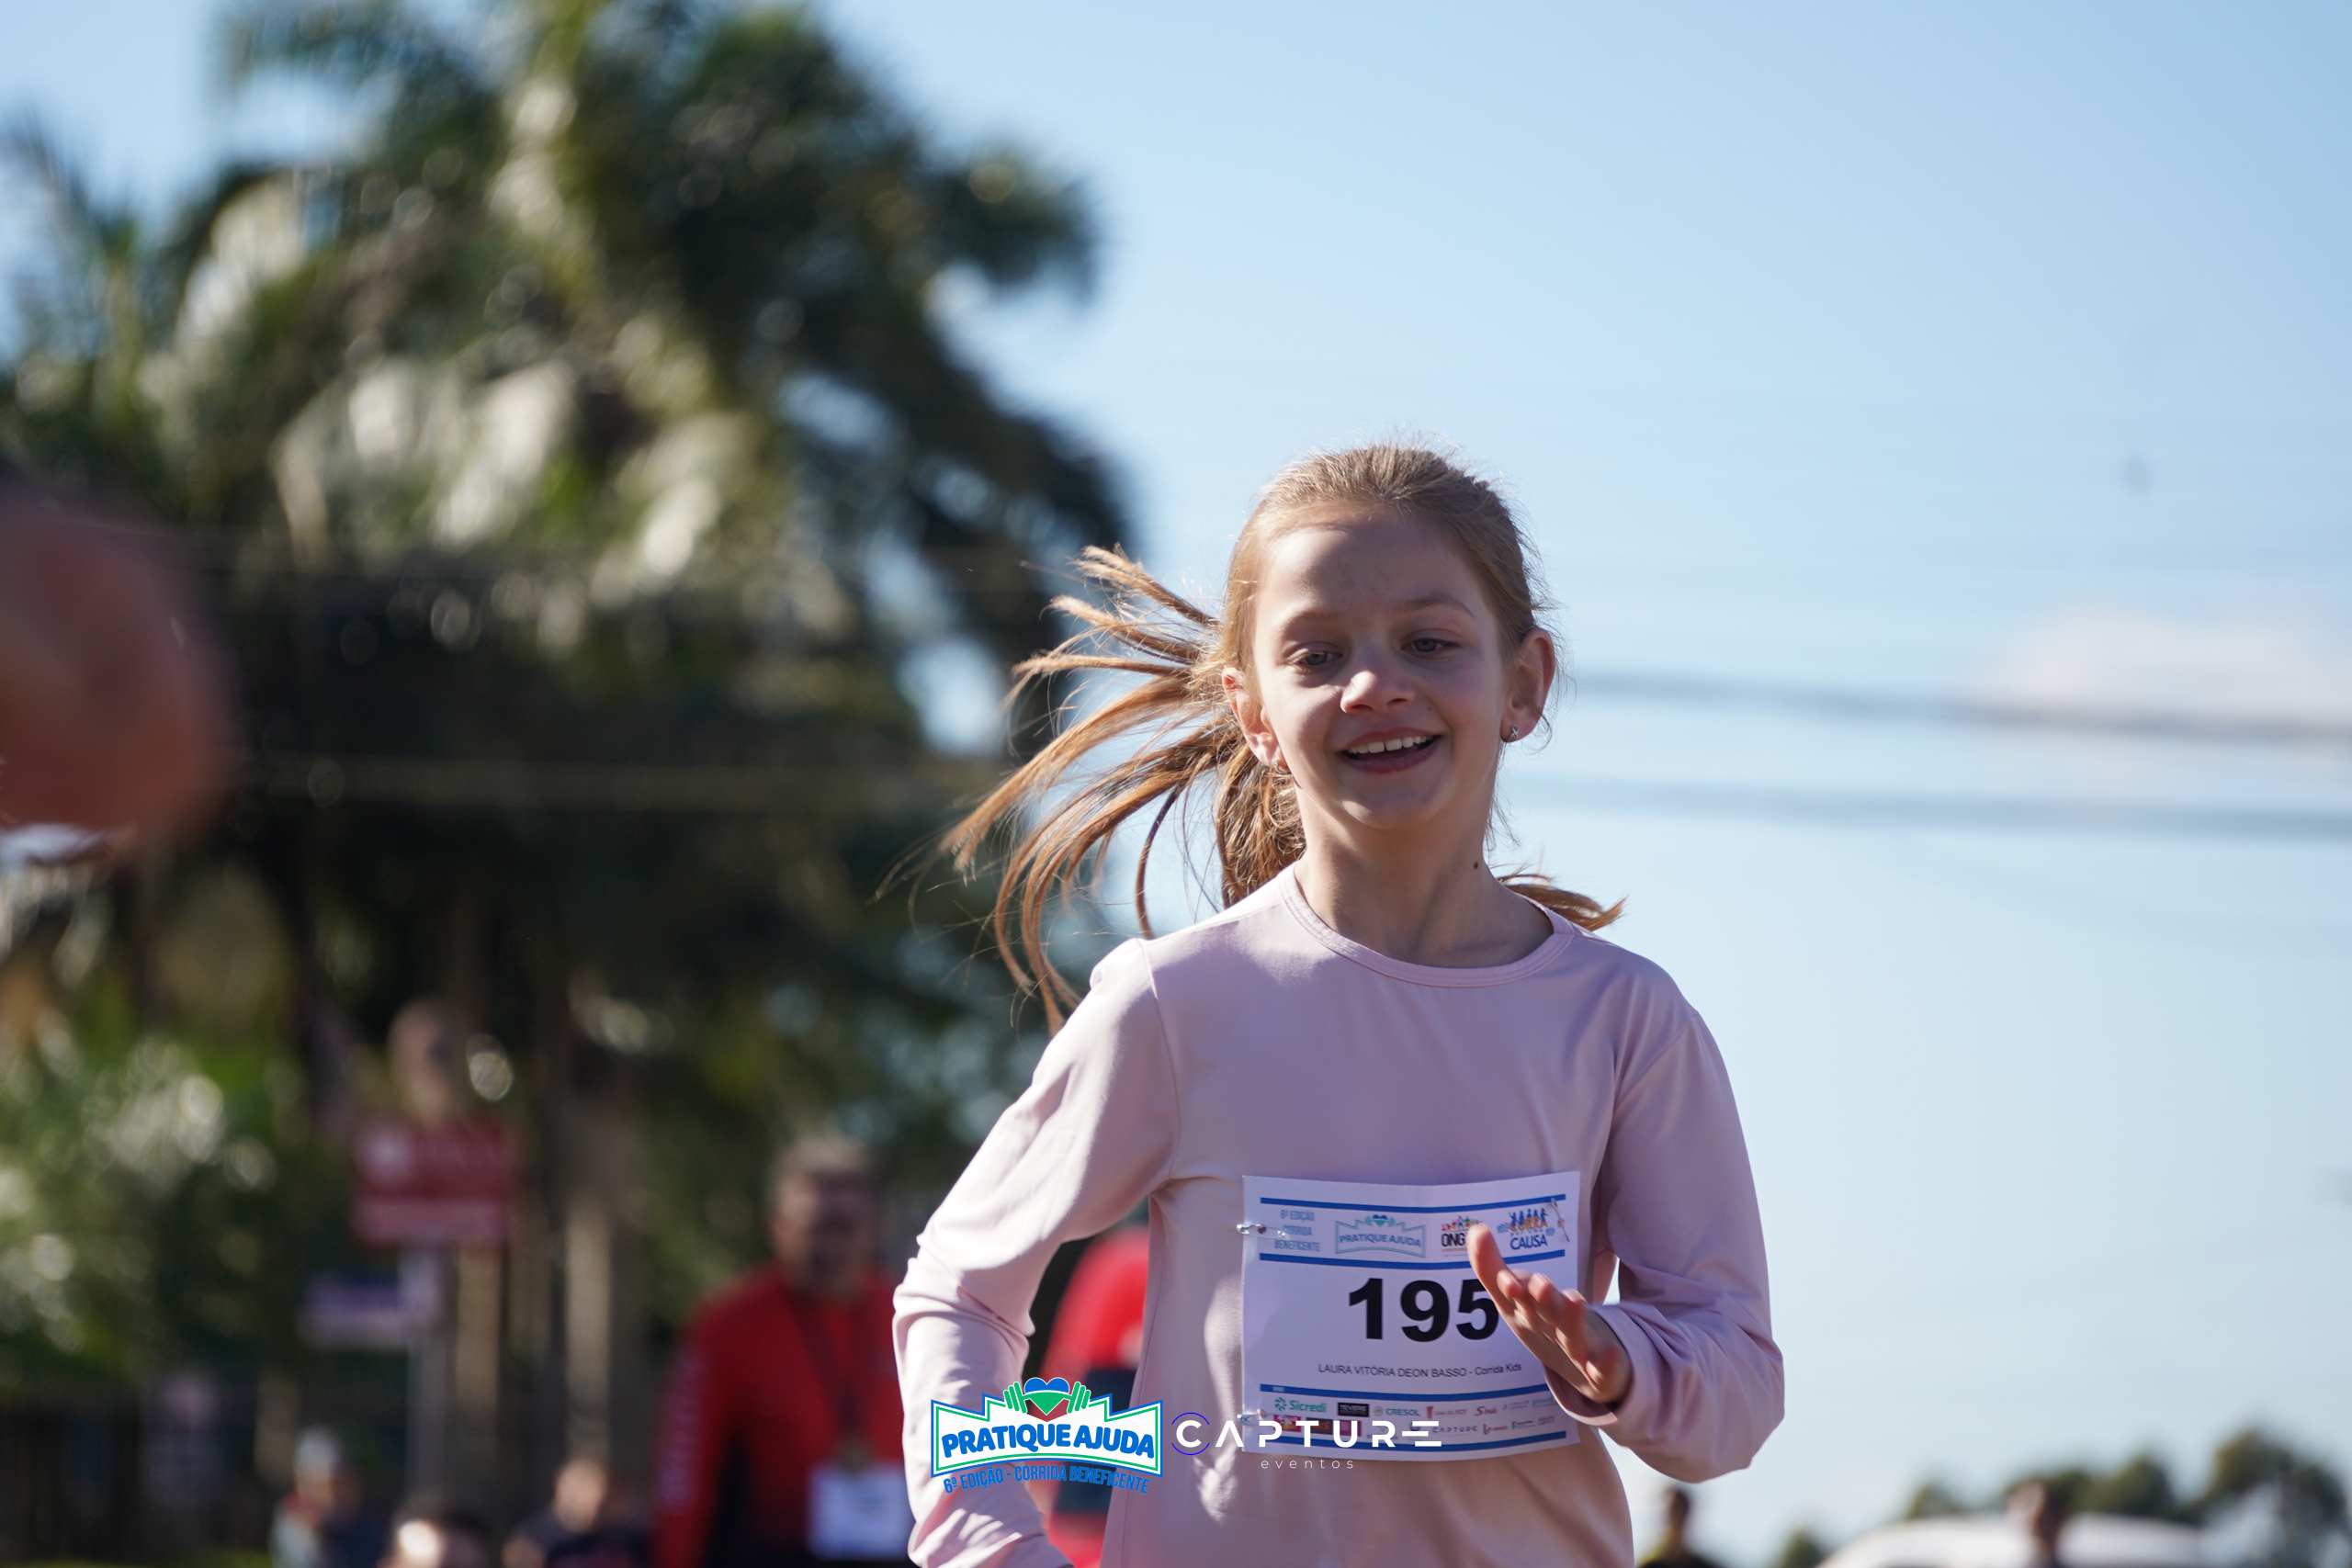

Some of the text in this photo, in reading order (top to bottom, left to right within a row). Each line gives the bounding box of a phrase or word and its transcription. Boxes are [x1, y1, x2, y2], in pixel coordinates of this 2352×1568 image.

[1274, 1240, 1321, 1252] BENEFICENTE
[1339, 1234, 1421, 1247] PRATIQUE AJUDA
[1510, 1234, 1548, 1250] CAUSA
[1348, 1277, 1500, 1343] 195
[1317, 1363, 1352, 1375] LAURA
[1354, 1364, 1396, 1377] VITÓRIA
[1397, 1367, 1429, 1378] DEON
[1430, 1367, 1467, 1378] BASSO
[1475, 1365, 1504, 1376] Corrida
[1506, 1362, 1521, 1373] Kids
[1289, 1400, 1328, 1413] Sicredi
[1385, 1407, 1420, 1416] CRESOL
